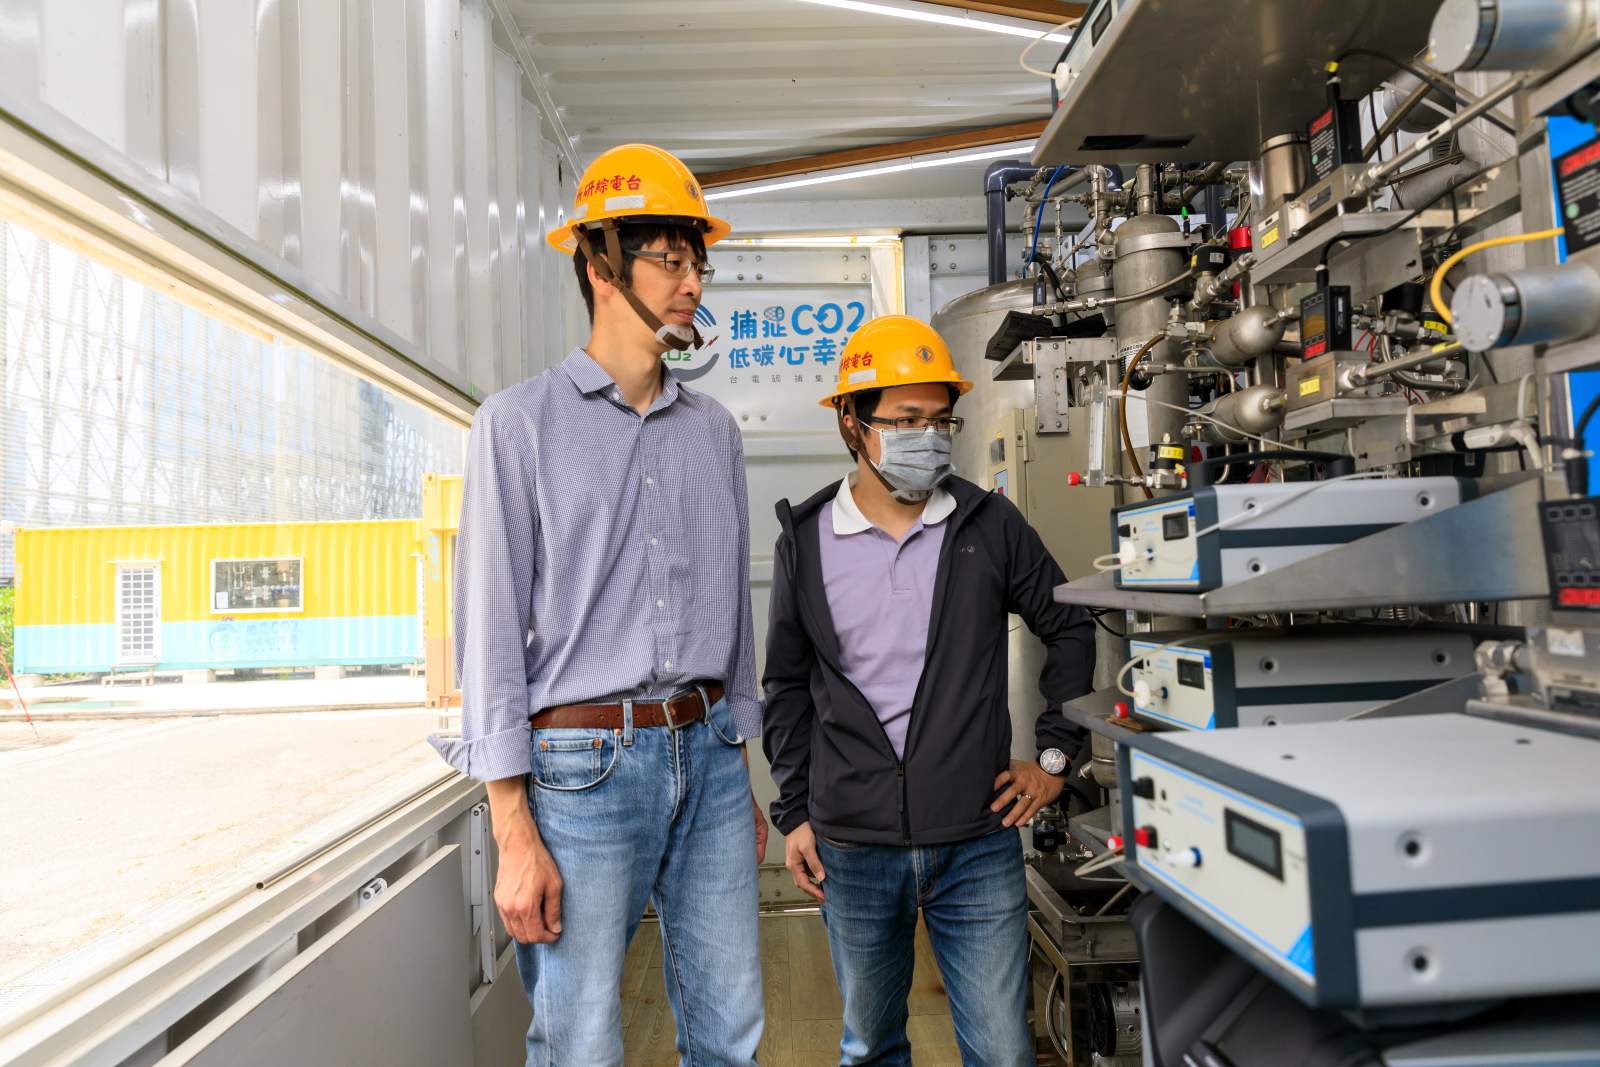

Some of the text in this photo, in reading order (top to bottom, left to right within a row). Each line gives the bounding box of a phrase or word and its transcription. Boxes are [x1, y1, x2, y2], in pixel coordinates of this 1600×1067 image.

[661, 351, 692, 361] O2
[729, 337, 848, 369] 低碳心幸
